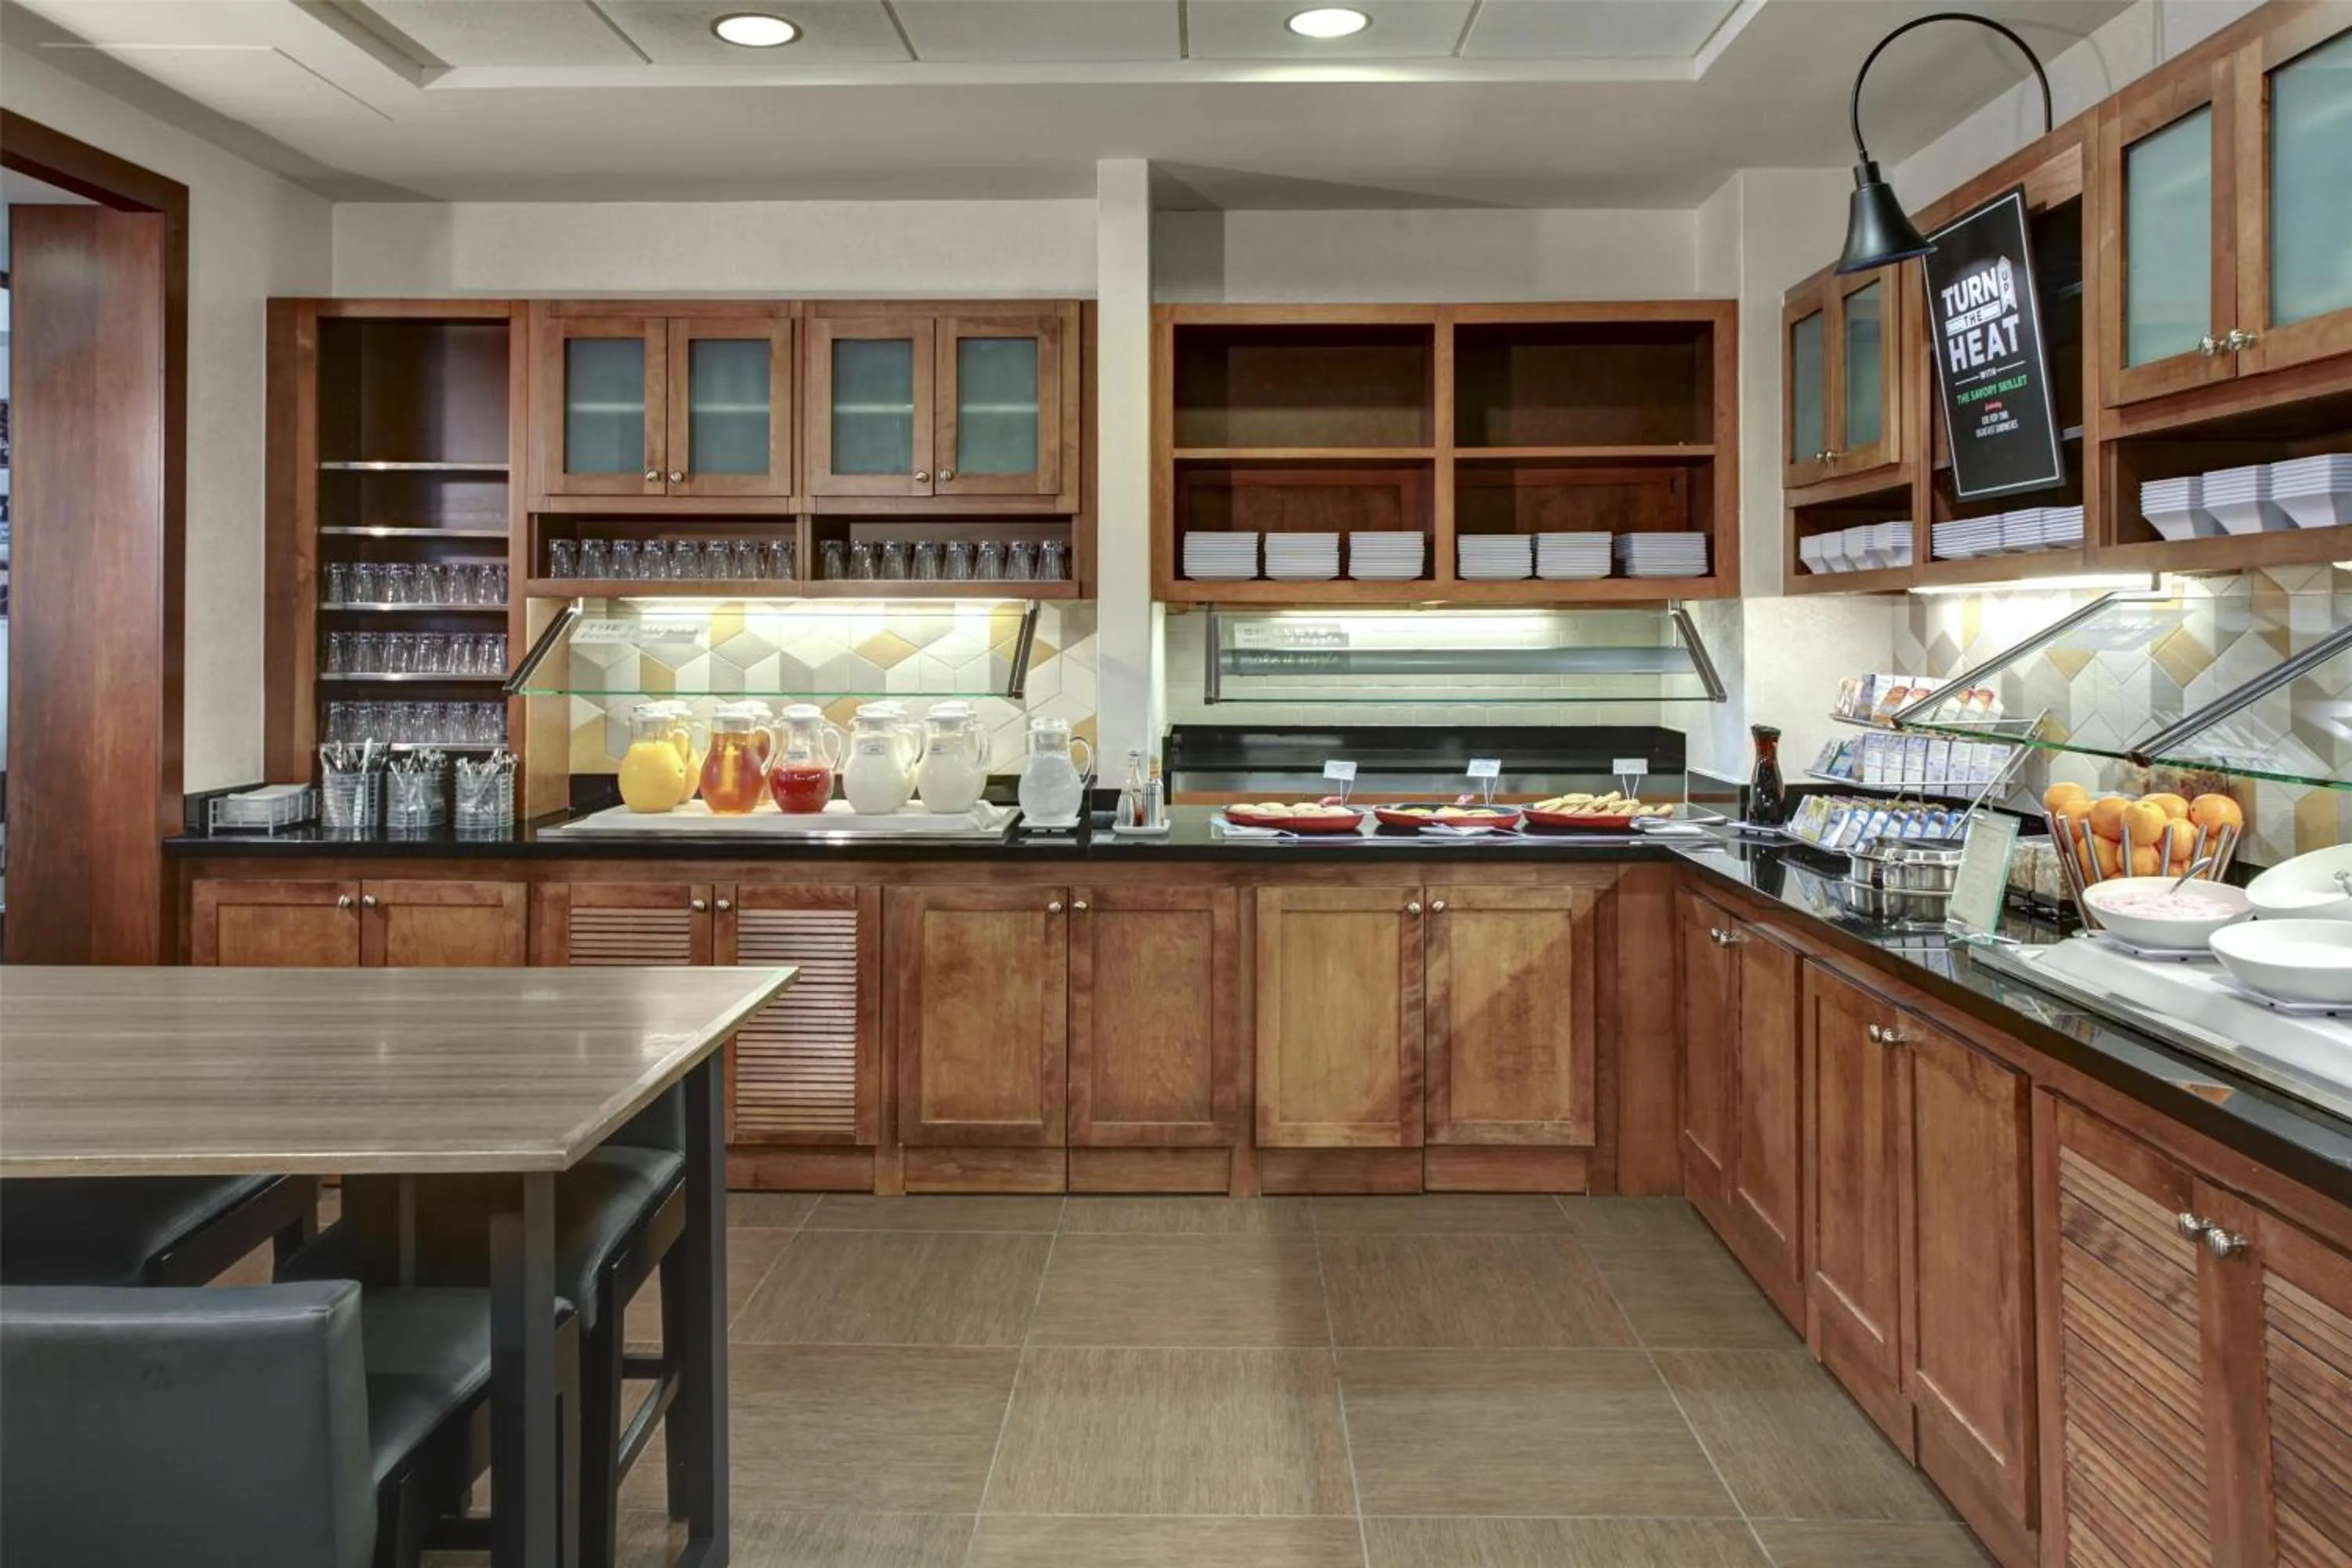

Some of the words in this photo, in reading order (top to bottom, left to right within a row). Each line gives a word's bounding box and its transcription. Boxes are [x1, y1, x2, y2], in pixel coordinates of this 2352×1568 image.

[1941, 267, 1999, 318] TURN
[2002, 271, 2009, 292] UP
[1963, 310, 1982, 327] THE
[1948, 314, 2020, 373] HEAT
[1956, 392, 1970, 406] THE
[1970, 384, 1997, 401] SAVORY
[1998, 374, 2028, 393] SKILLET
